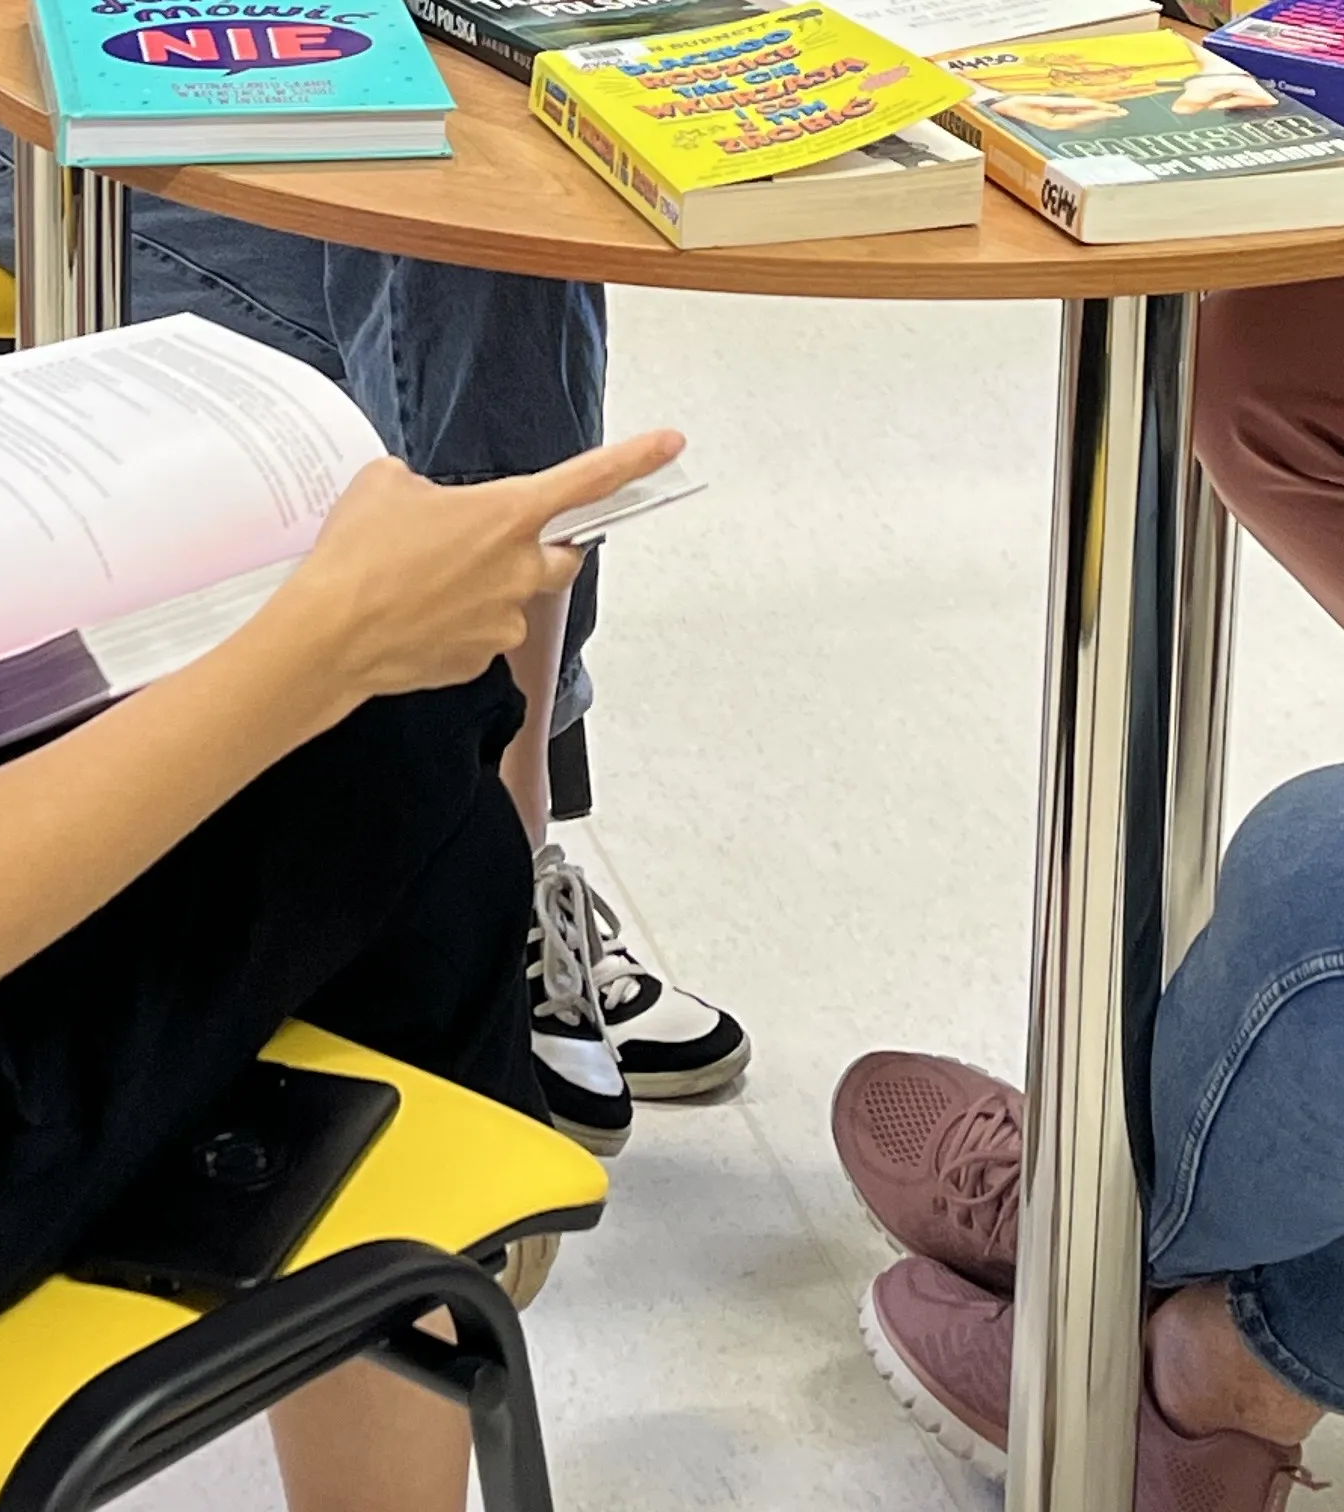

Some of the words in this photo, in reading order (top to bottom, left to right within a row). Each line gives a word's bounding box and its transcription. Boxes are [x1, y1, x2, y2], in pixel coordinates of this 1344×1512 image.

[134, 0, 379, 25] mówić
[437, 5, 477, 46] POLSKA
[136, 26, 343, 63] NIE
[637, 44, 802, 88] RODZICE
[713, 96, 878, 155] ZROBIĆ
[1145, 159, 1196, 177] ert
